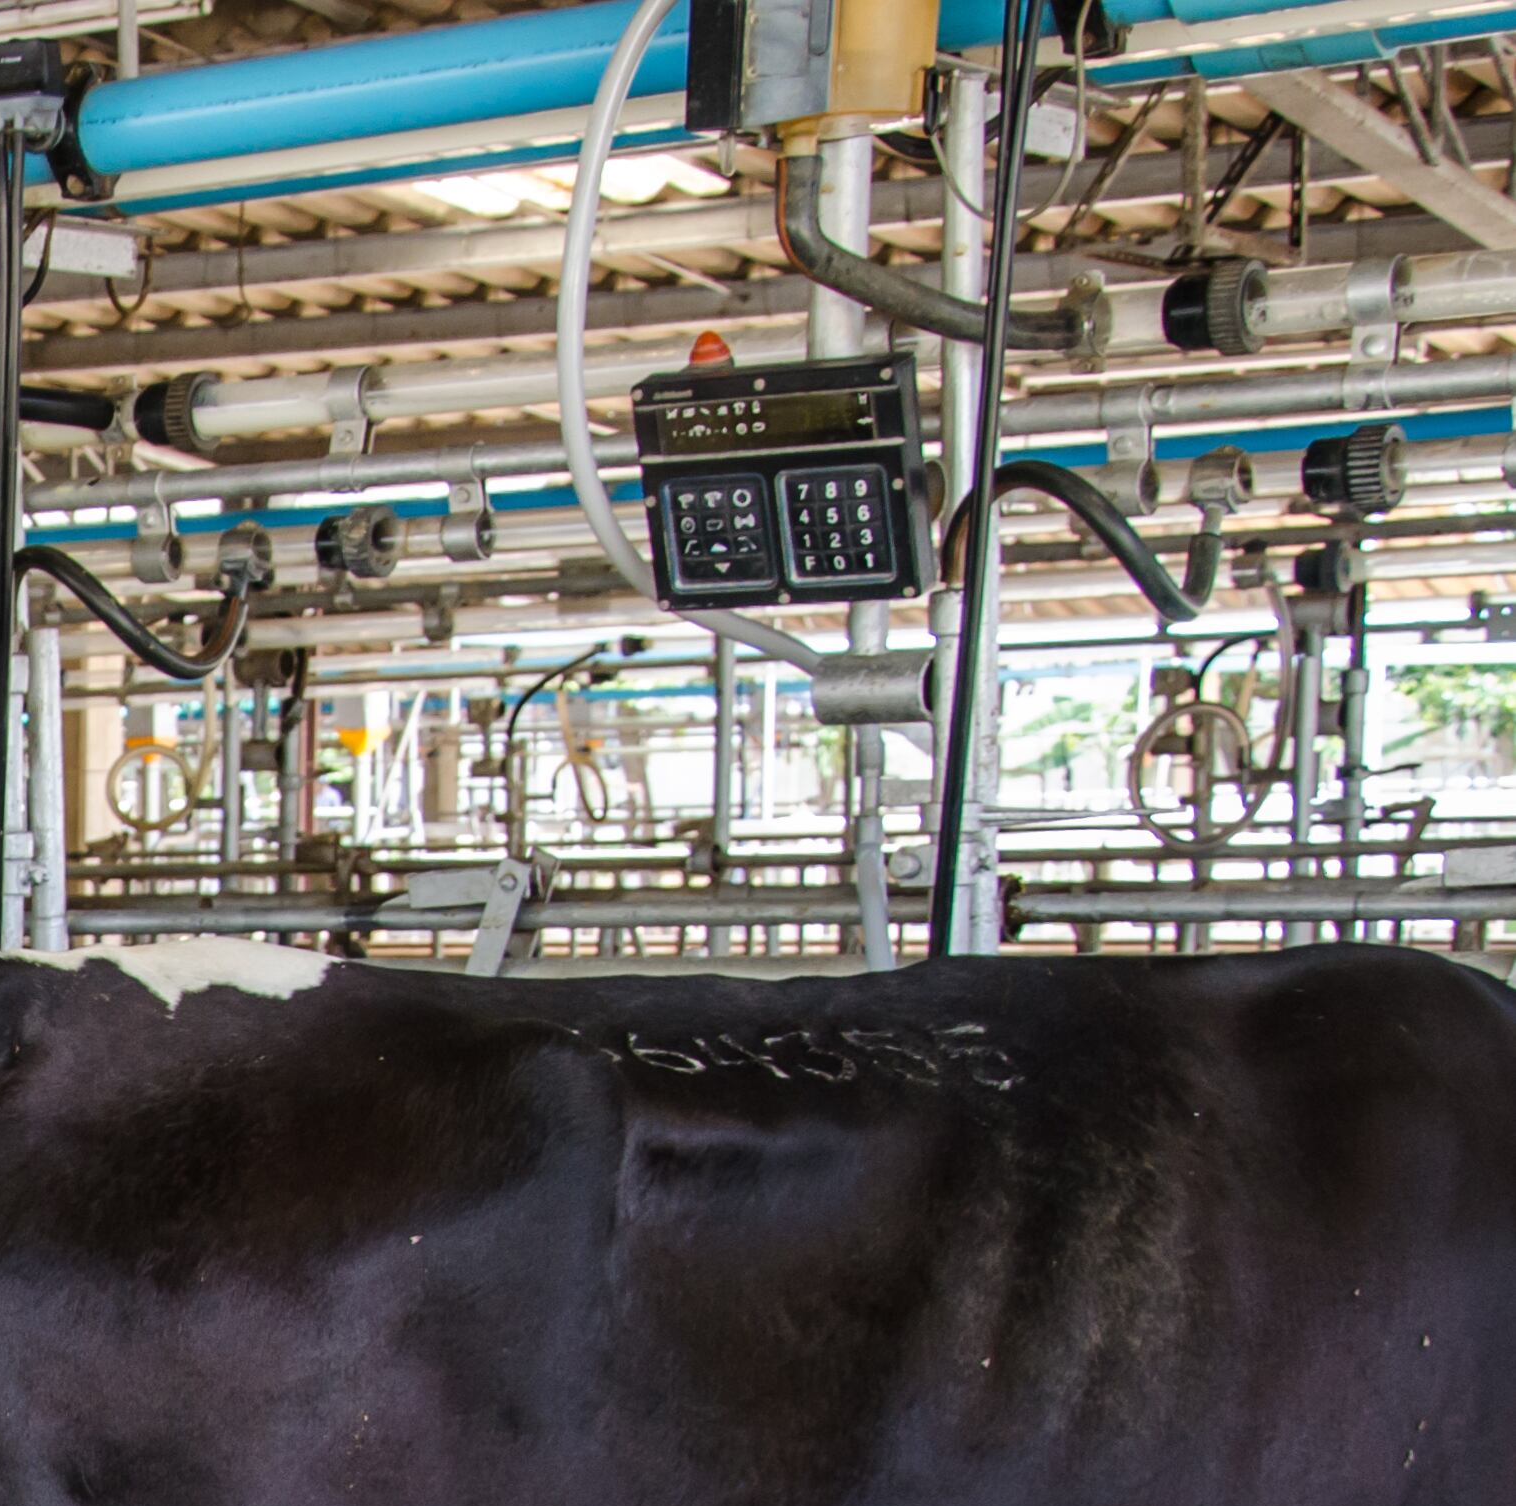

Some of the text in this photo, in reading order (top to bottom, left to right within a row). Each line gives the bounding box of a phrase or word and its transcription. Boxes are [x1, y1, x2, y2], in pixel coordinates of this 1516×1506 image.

[798, 480, 867, 500] 7 8 9
[800, 505, 870, 524] 4 5 6
[804, 529, 872, 548] 1 2 3
[805, 556, 845, 570] F 0
